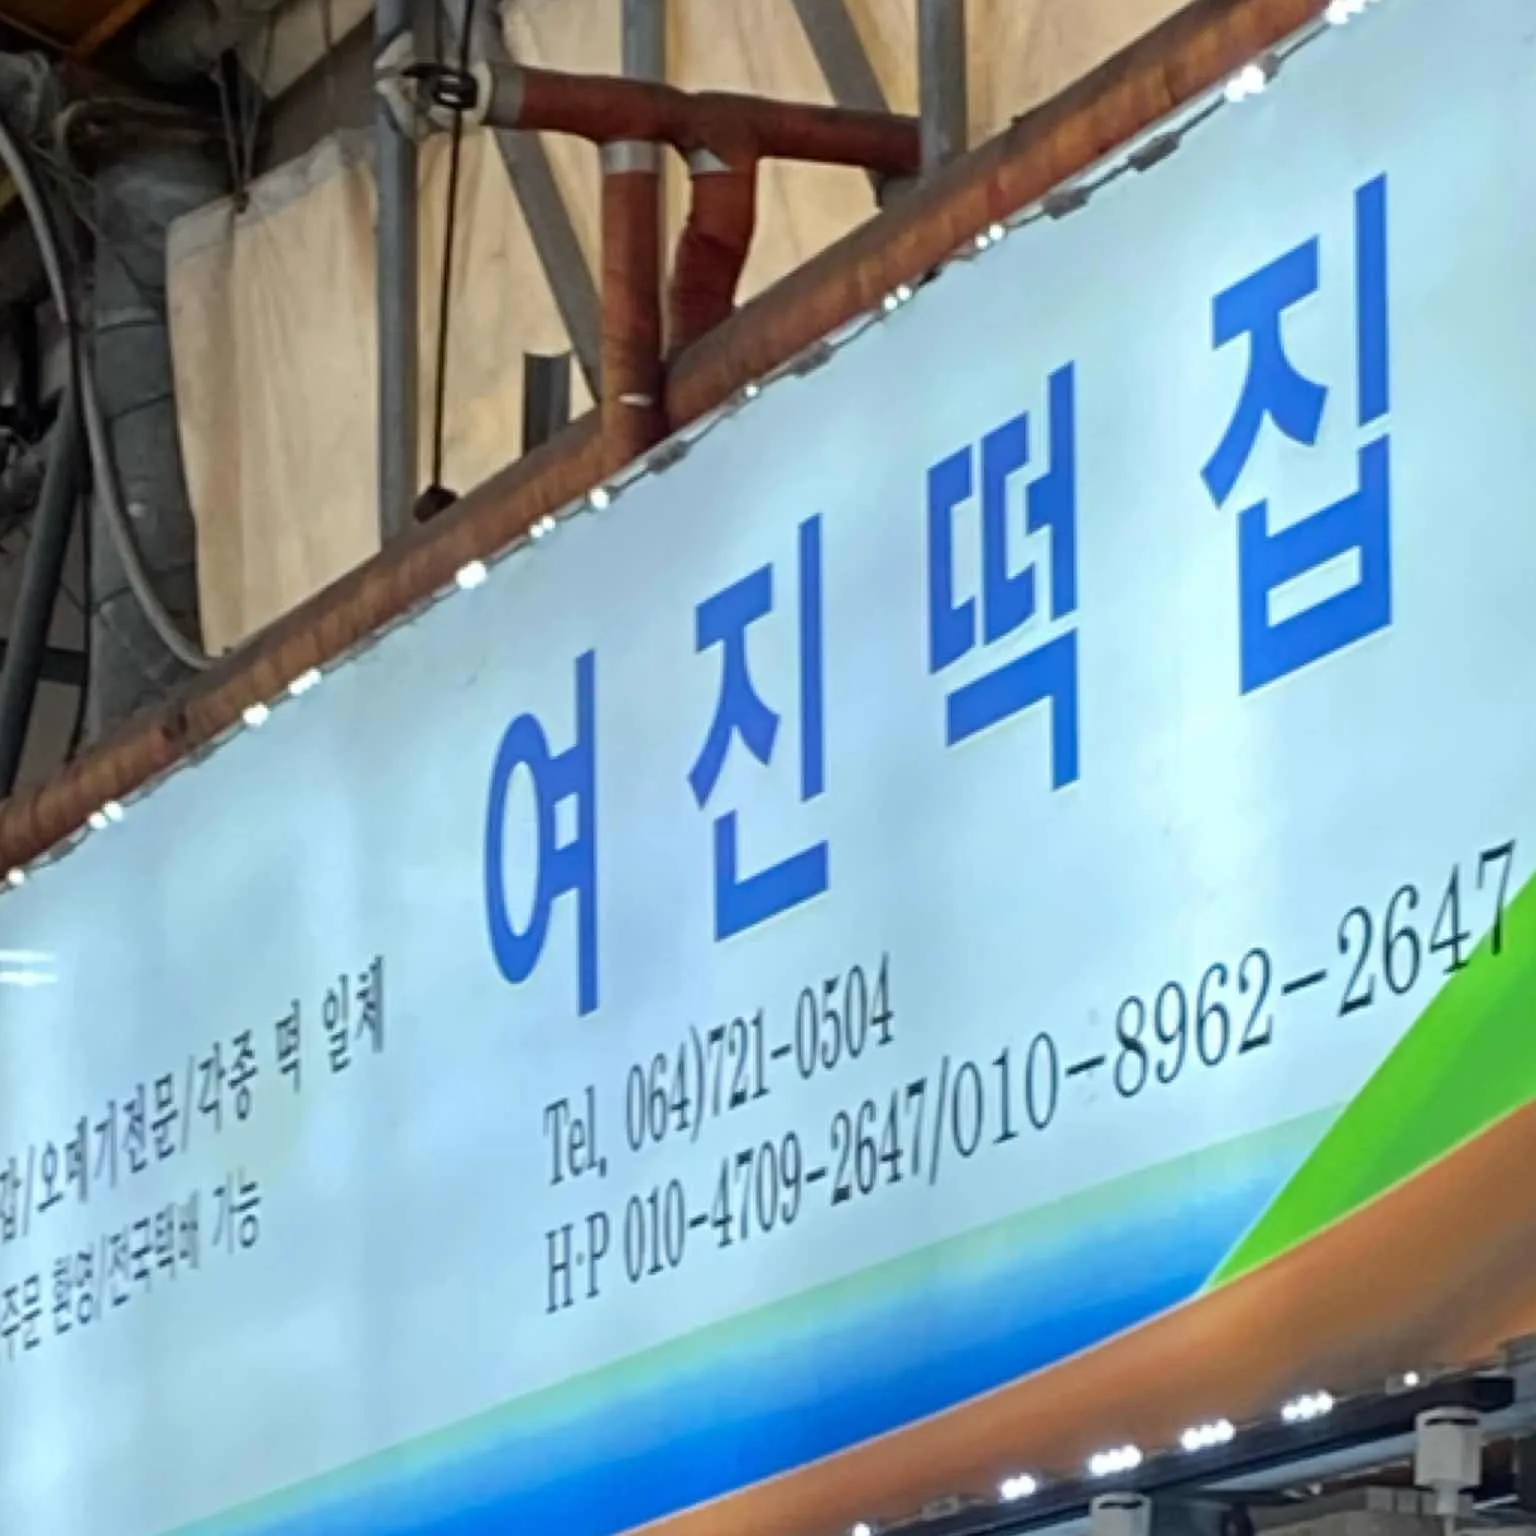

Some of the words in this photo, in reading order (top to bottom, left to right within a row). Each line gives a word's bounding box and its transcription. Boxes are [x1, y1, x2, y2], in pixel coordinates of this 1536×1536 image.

[484, 175, 1394, 1017] 여진떡집
[624, 950, 895, 1155] 064)721-0504
[211, 1166, 262, 1255] 가능
